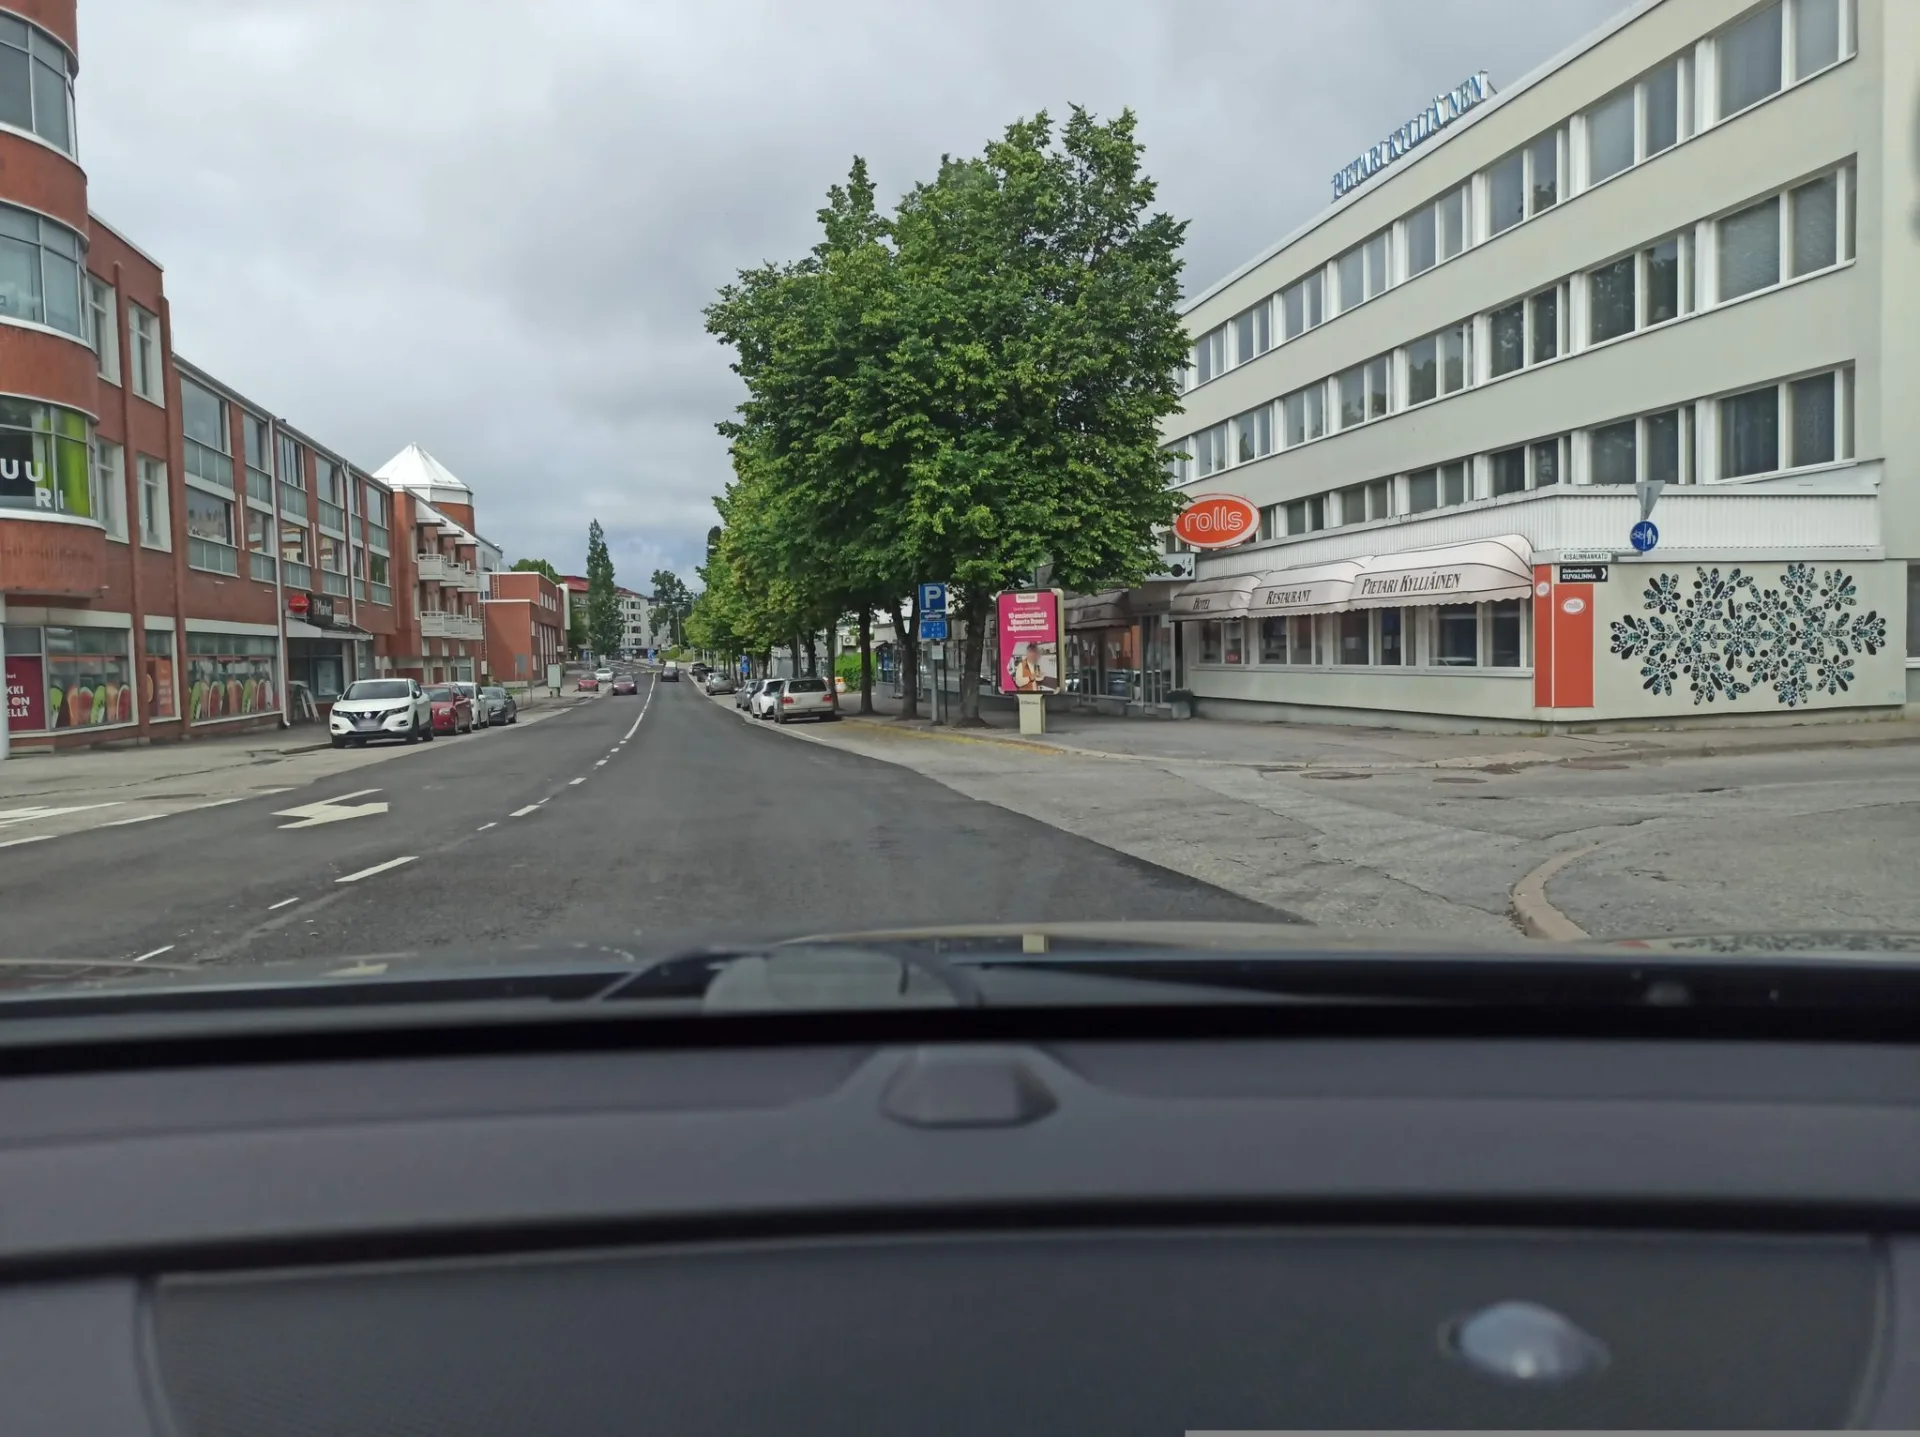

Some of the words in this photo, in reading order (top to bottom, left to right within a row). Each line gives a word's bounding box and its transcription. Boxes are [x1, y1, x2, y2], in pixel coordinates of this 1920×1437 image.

[1184, 506, 1244, 533] rolls
[1361, 578, 1399, 595] PIETARI
[1399, 571, 1462, 592] KYLLIÄINEN
[925, 586, 941, 608] P
[1266, 589, 1312, 605] RESTAURANT
